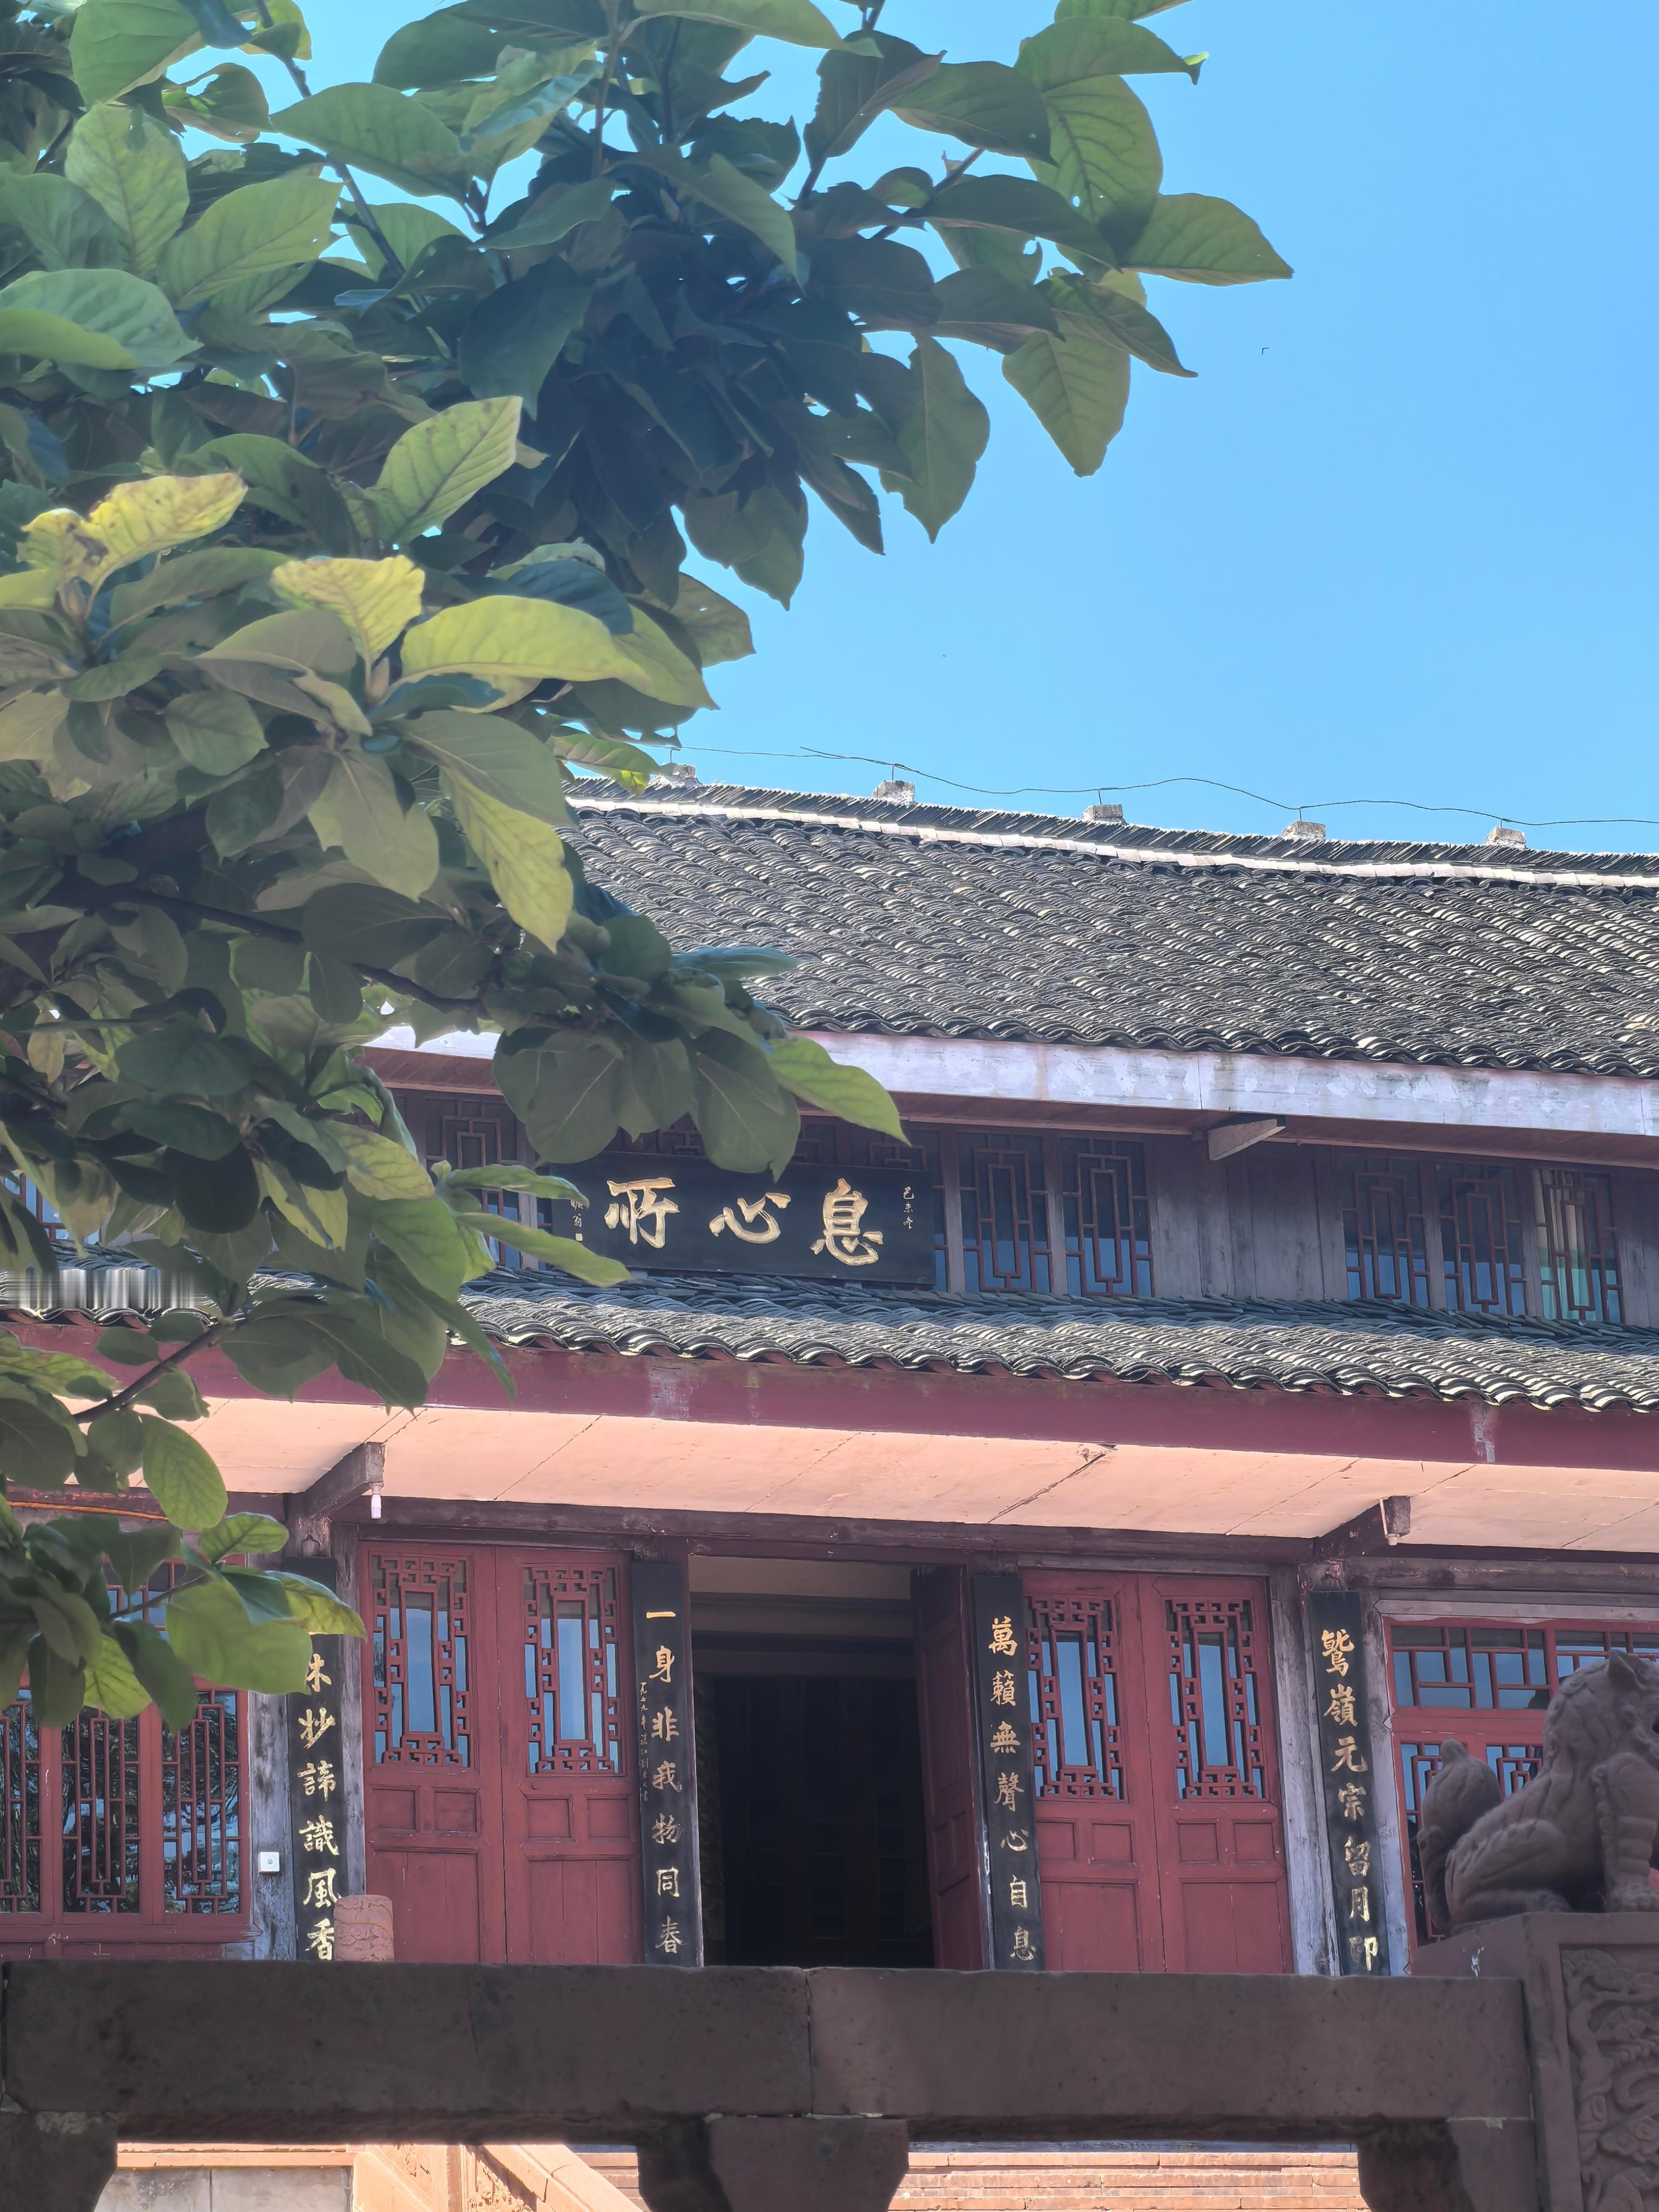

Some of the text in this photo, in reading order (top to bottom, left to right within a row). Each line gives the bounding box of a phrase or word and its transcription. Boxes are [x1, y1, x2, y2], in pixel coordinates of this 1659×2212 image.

[645, 1610, 686, 1954] 一身非我物同春
[988, 1615, 1037, 1961] 萬籟無聲心自息
